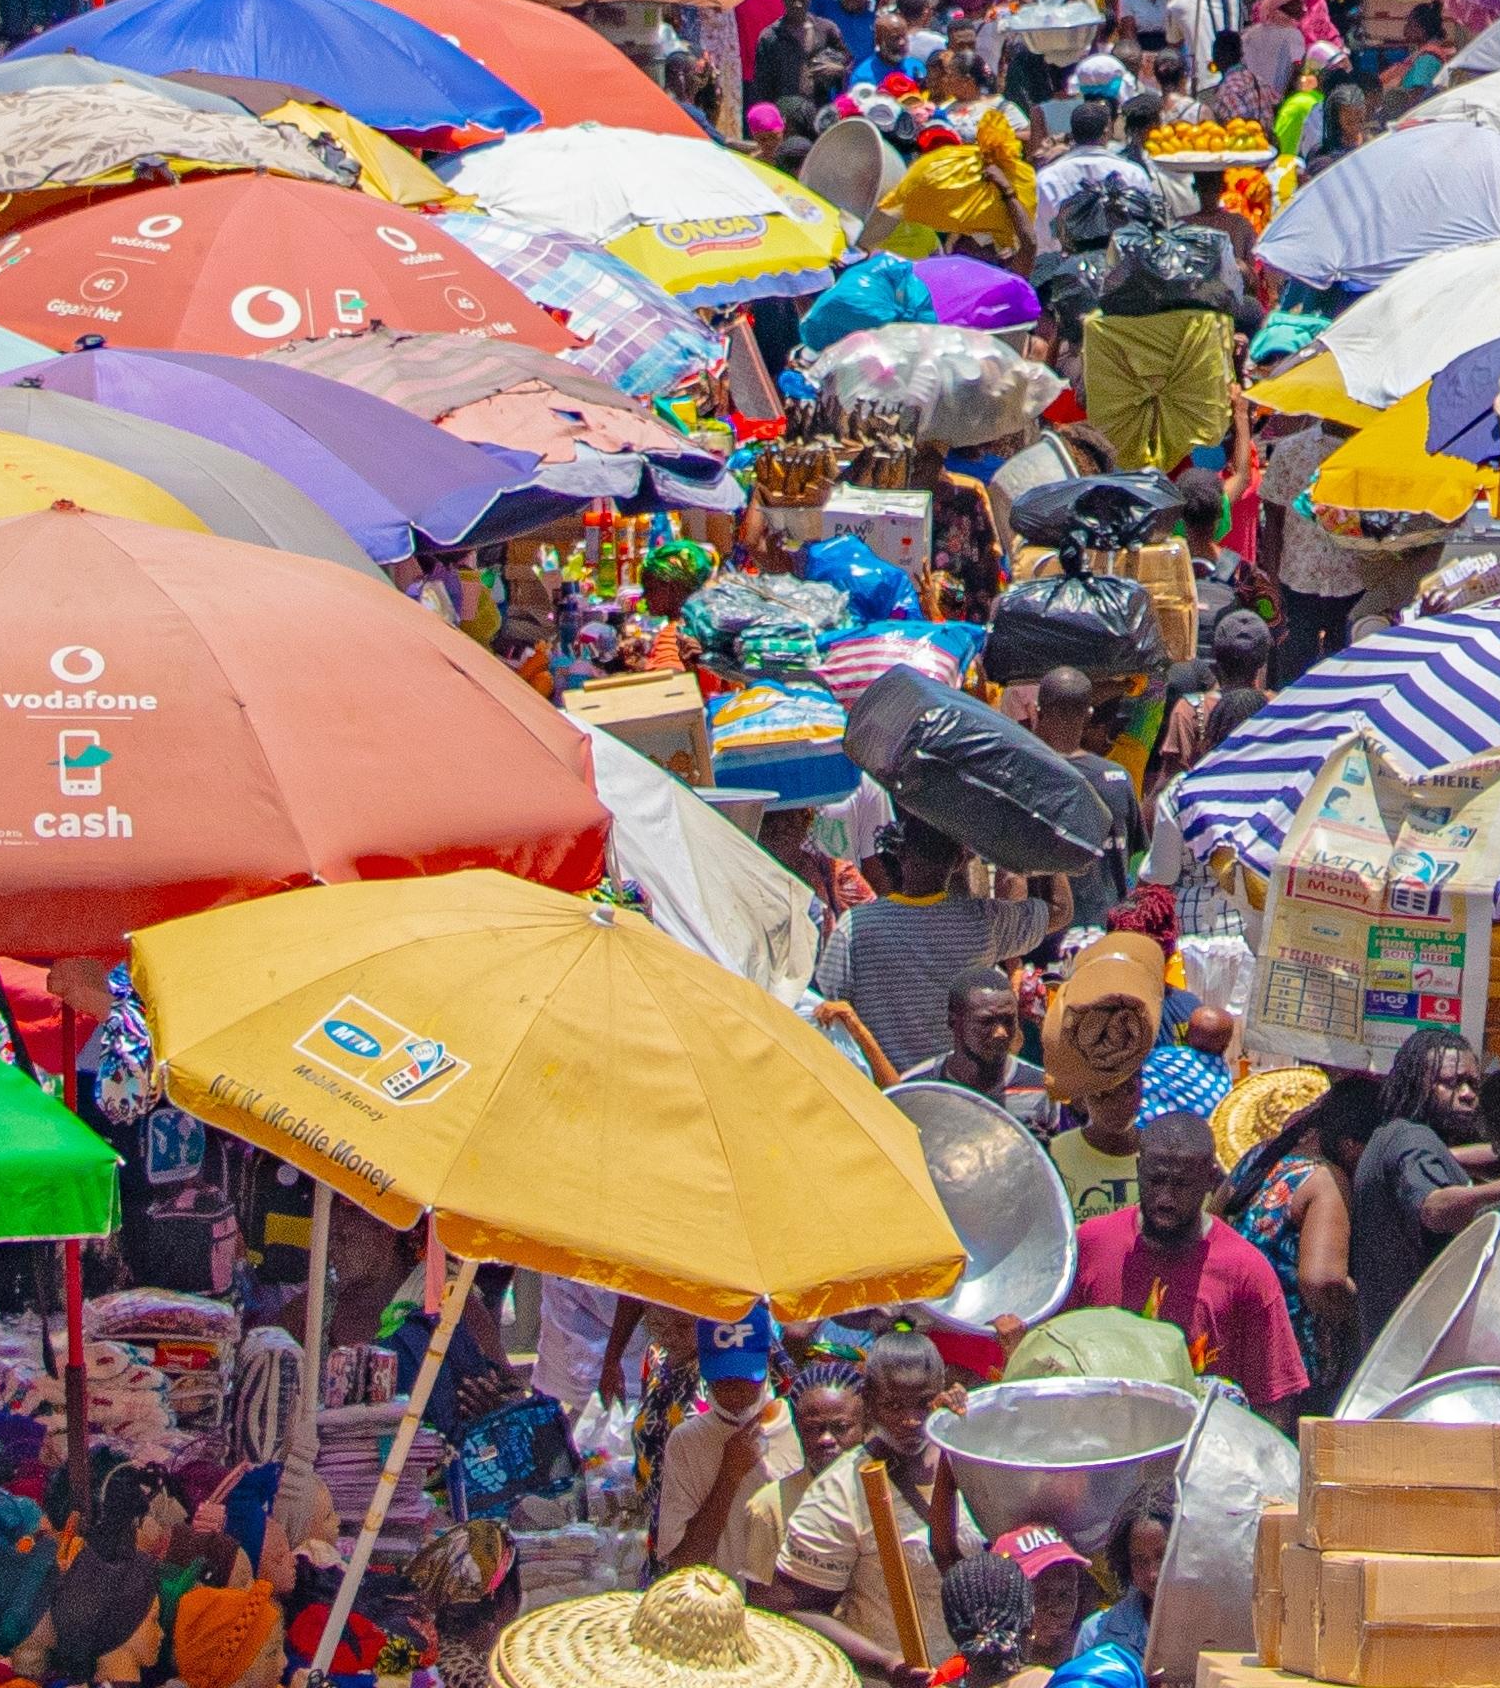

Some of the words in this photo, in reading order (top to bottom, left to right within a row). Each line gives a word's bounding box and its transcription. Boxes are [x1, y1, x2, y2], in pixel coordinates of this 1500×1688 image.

[110, 235, 171, 252] vodafone
[662, 216, 758, 245] ONGA
[93, 278, 116, 292] 4G
[93, 305, 123, 322] Net
[835, 522, 868, 534] PAW
[2, 690, 158, 710] vodafone
[34, 805, 133, 838] cash
[1307, 878, 1371, 905] Money
[1403, 927, 1442, 941] KINDS
[1277, 946, 1362, 974] TRANSFER
[1381, 948, 1417, 961] SOLD
[1420, 952, 1451, 964] HERE
[330, 1025, 378, 1054] MTN
[292, 1063, 341, 1097] Mobile
[340, 1090, 389, 1123] Money
[208, 1073, 263, 1113] MTN
[264, 1100, 331, 1153] Mobile
[329, 1138, 397, 1198] Money
[713, 1323, 755, 1349] CF
